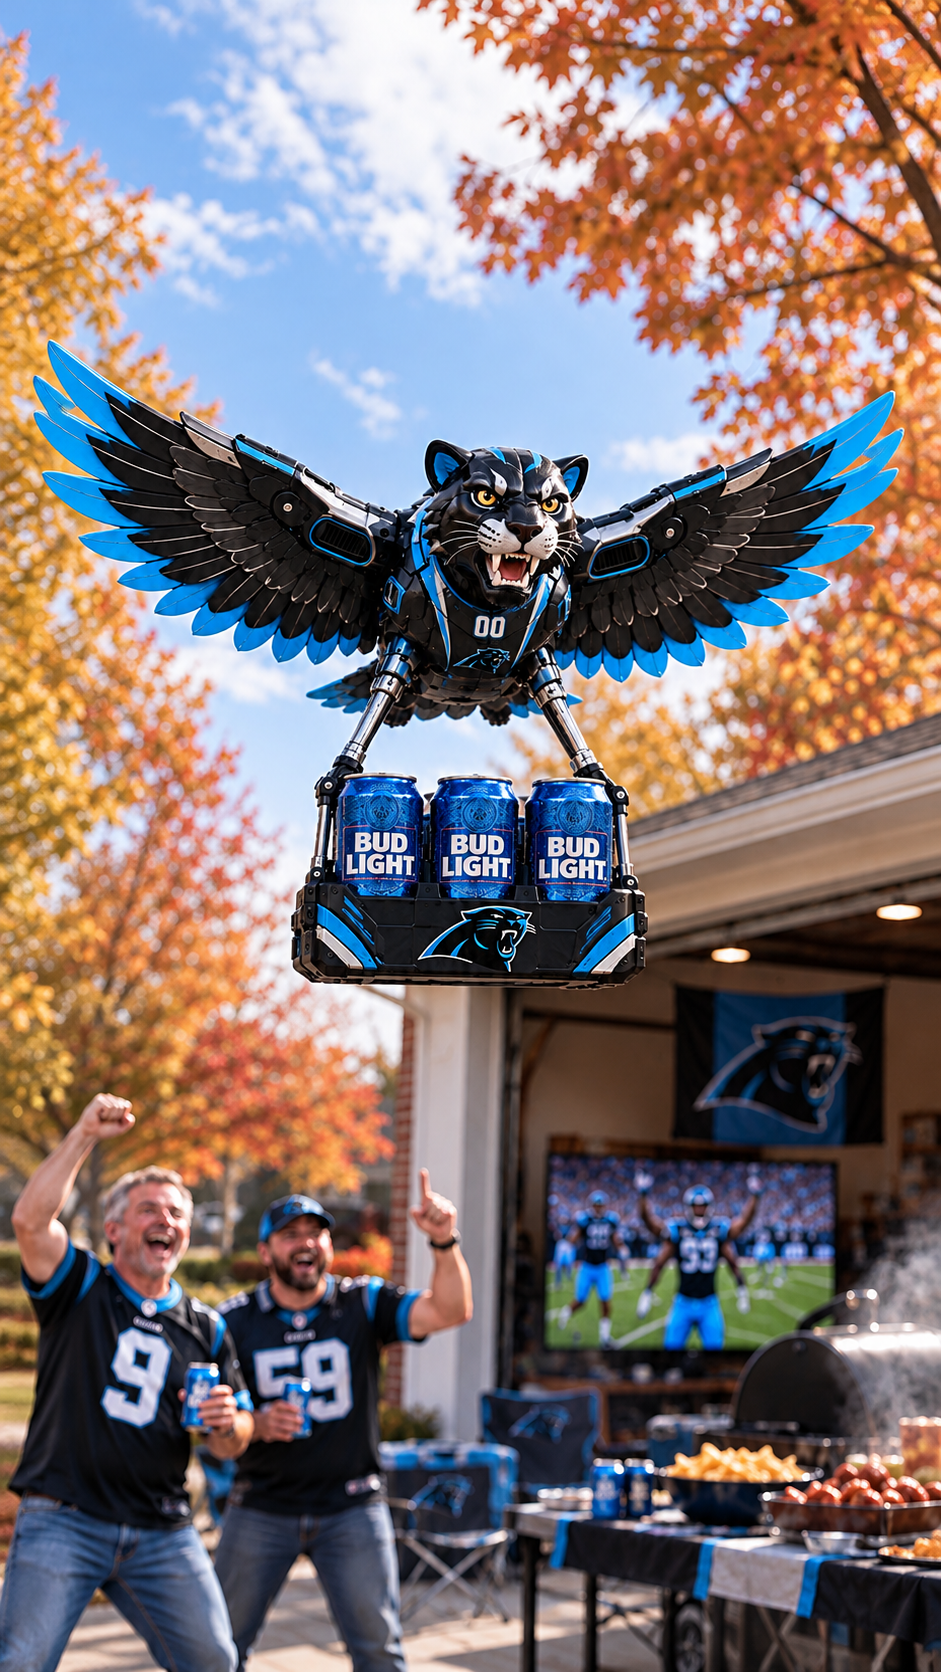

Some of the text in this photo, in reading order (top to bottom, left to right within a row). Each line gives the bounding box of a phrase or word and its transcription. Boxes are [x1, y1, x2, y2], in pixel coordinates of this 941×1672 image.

[474, 615, 505, 638] 00
[355, 832, 408, 853] BUD
[451, 834, 504, 855] BUD
[548, 836, 600, 857] BUD
[102, 1328, 171, 1427] 9
[254, 1338, 352, 1422] 59
